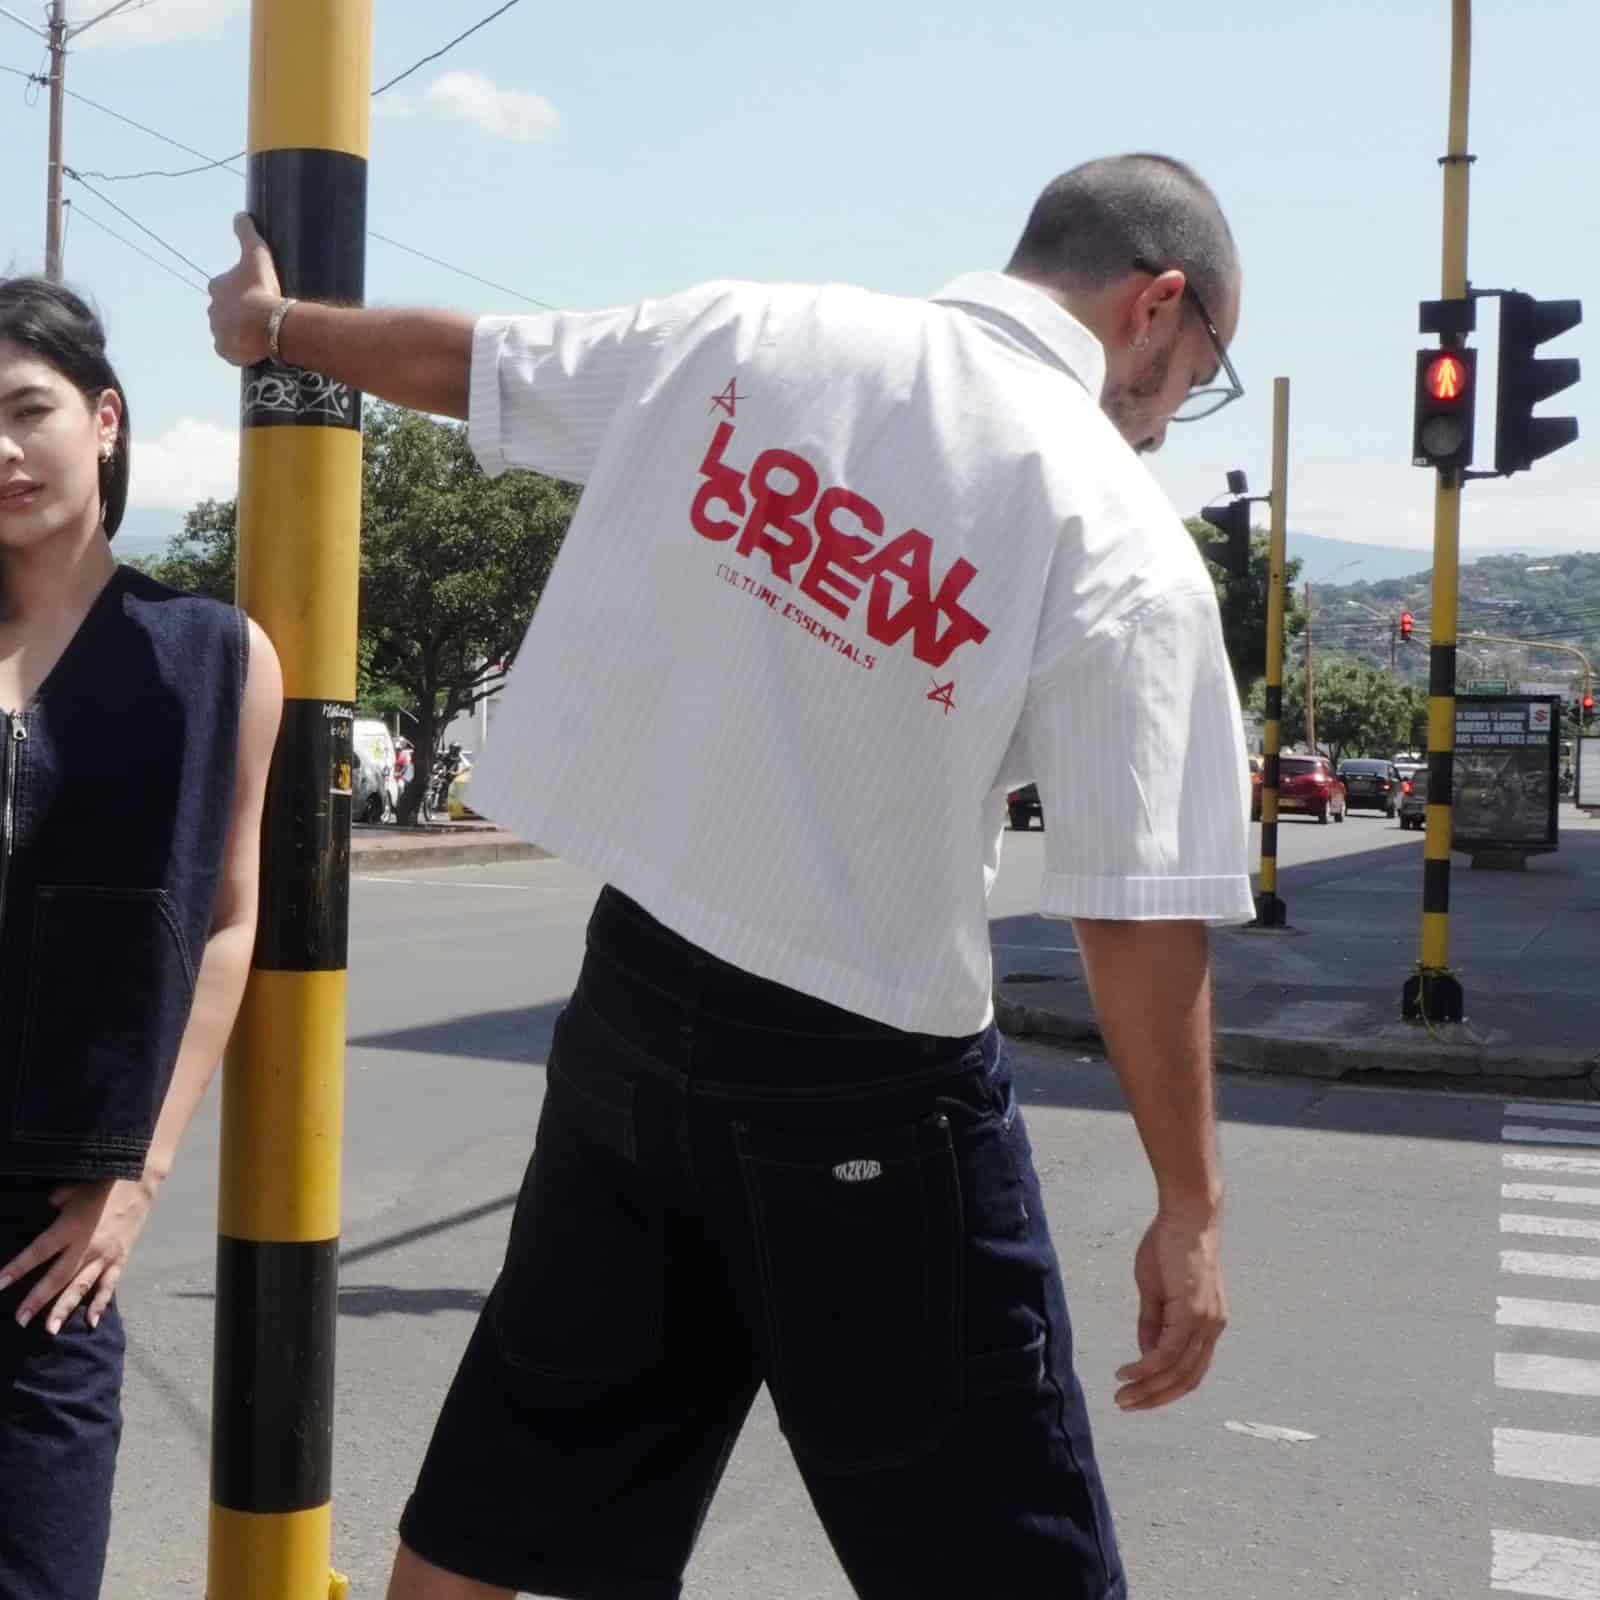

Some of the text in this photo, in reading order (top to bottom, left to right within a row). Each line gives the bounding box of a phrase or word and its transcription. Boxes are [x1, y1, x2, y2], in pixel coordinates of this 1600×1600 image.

[690, 477, 976, 668] CREW
[699, 421, 991, 645] LOCAL
[717, 563, 877, 670] CULTURE ESSENTIALS
